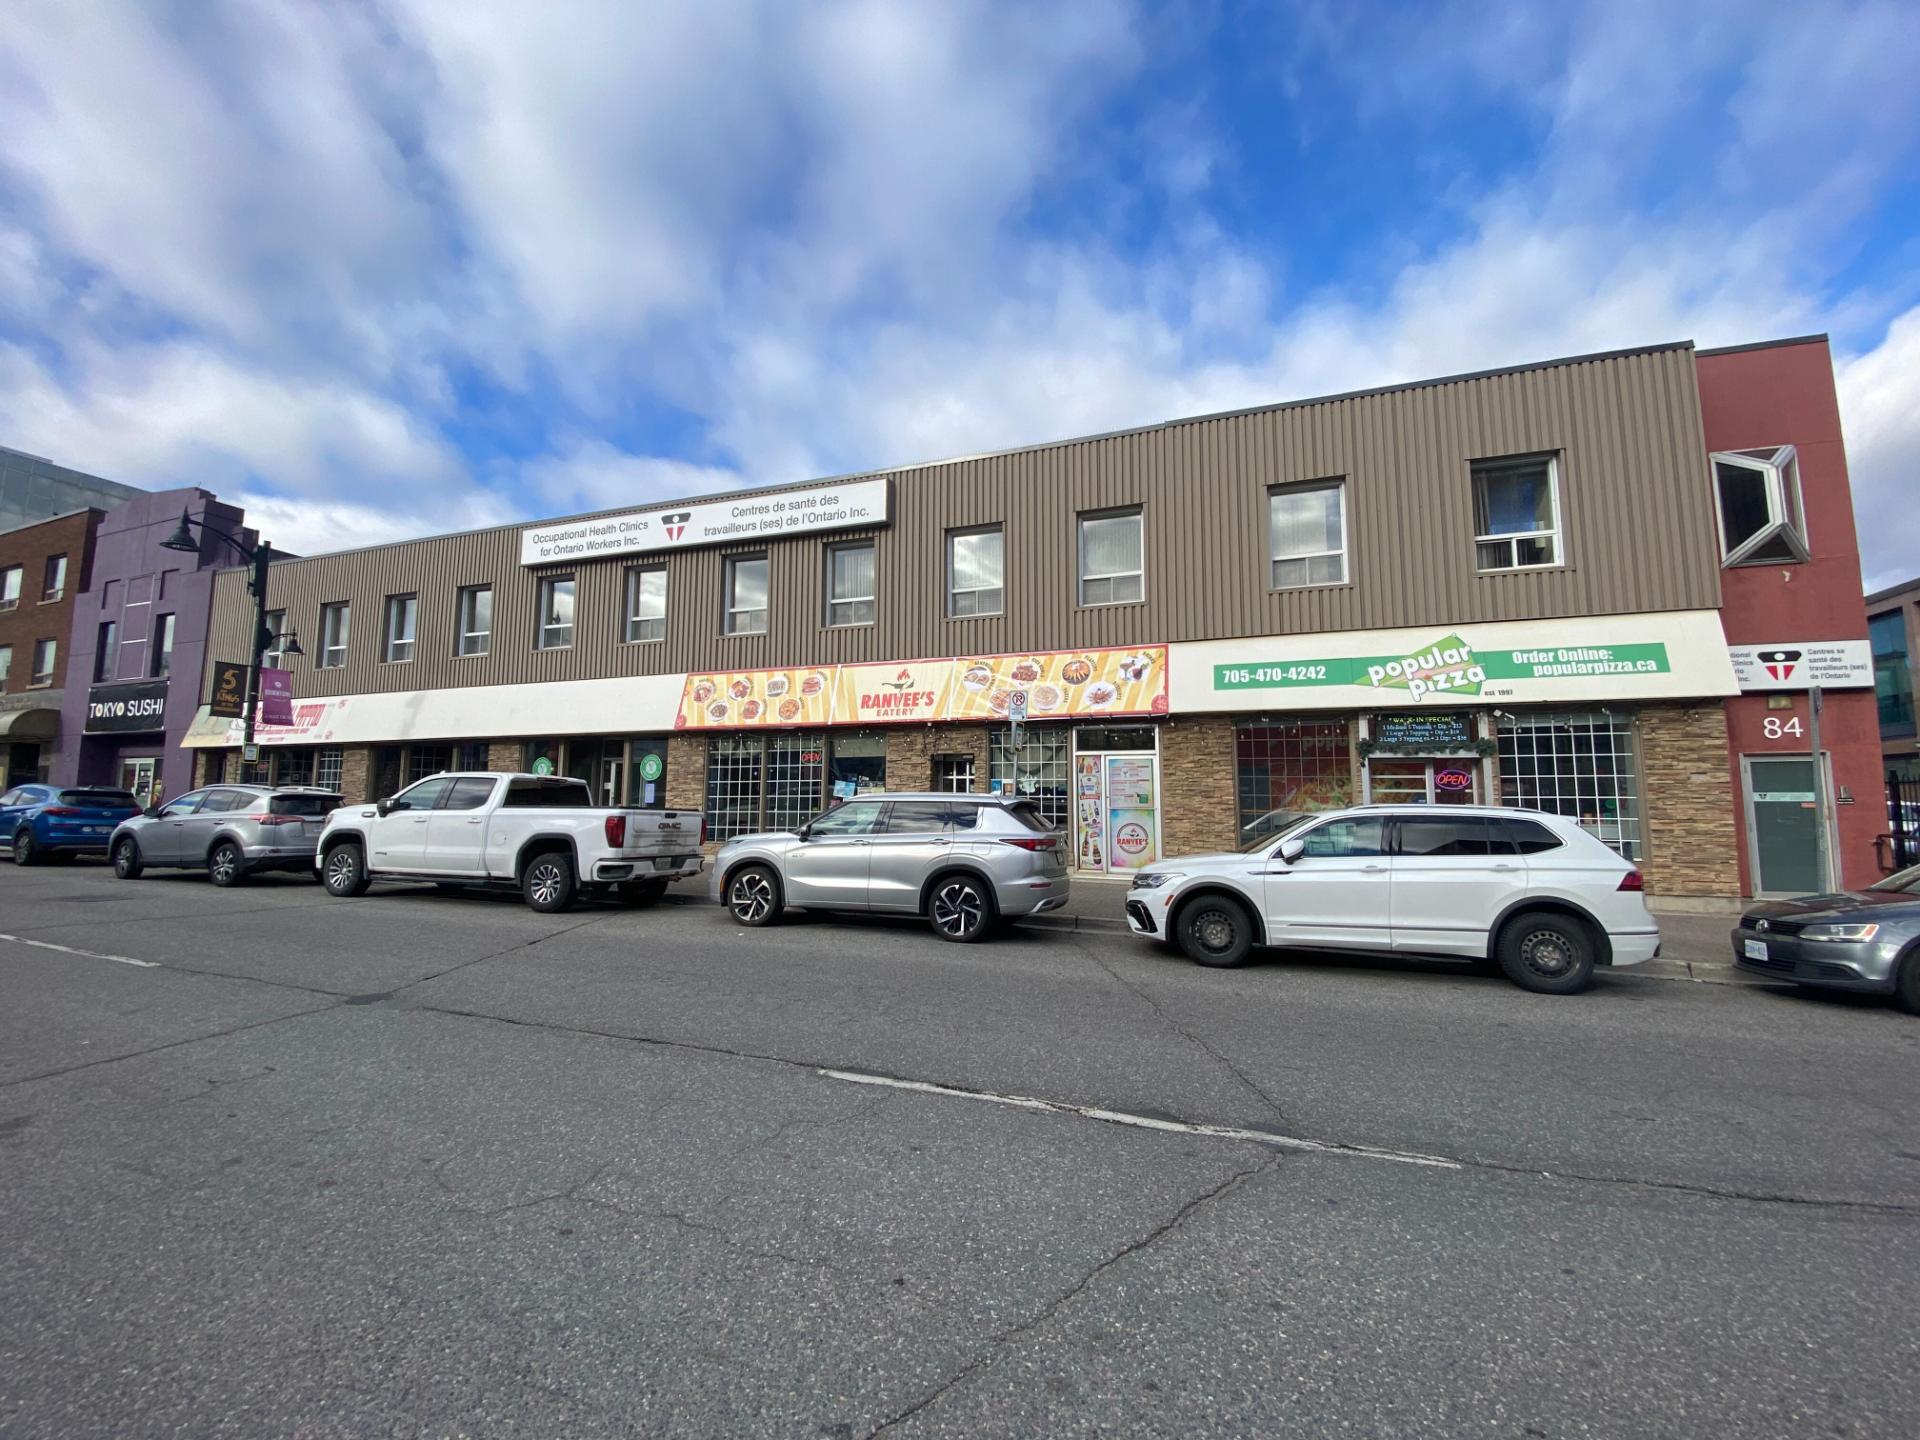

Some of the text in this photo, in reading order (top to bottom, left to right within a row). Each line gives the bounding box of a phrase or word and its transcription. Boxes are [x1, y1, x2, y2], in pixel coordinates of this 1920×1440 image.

[731, 494, 840, 518] Centres de santé des
[532, 520, 649, 544] Occupational Health Clinics
[704, 507, 870, 537] travailleurs (ses) de l'Ontario Inc.
[540, 536, 640, 557] for Ontario Workers Inc.
[1367, 645, 1472, 688] popular
[1511, 648, 1613, 664] Order Online:
[1222, 665, 1327, 684] 705-470-4242
[1532, 660, 1658, 677] popularpizza.ca
[1408, 665, 1487, 702] pizza
[89, 698, 164, 719] TOKYO SUSHI
[860, 690, 935, 709] RANVEE'S
[876, 707, 914, 717] EATERY
[1763, 716, 1804, 739] 84
[1437, 774, 1468, 785] OPEN
[658, 822, 682, 830] GMC
